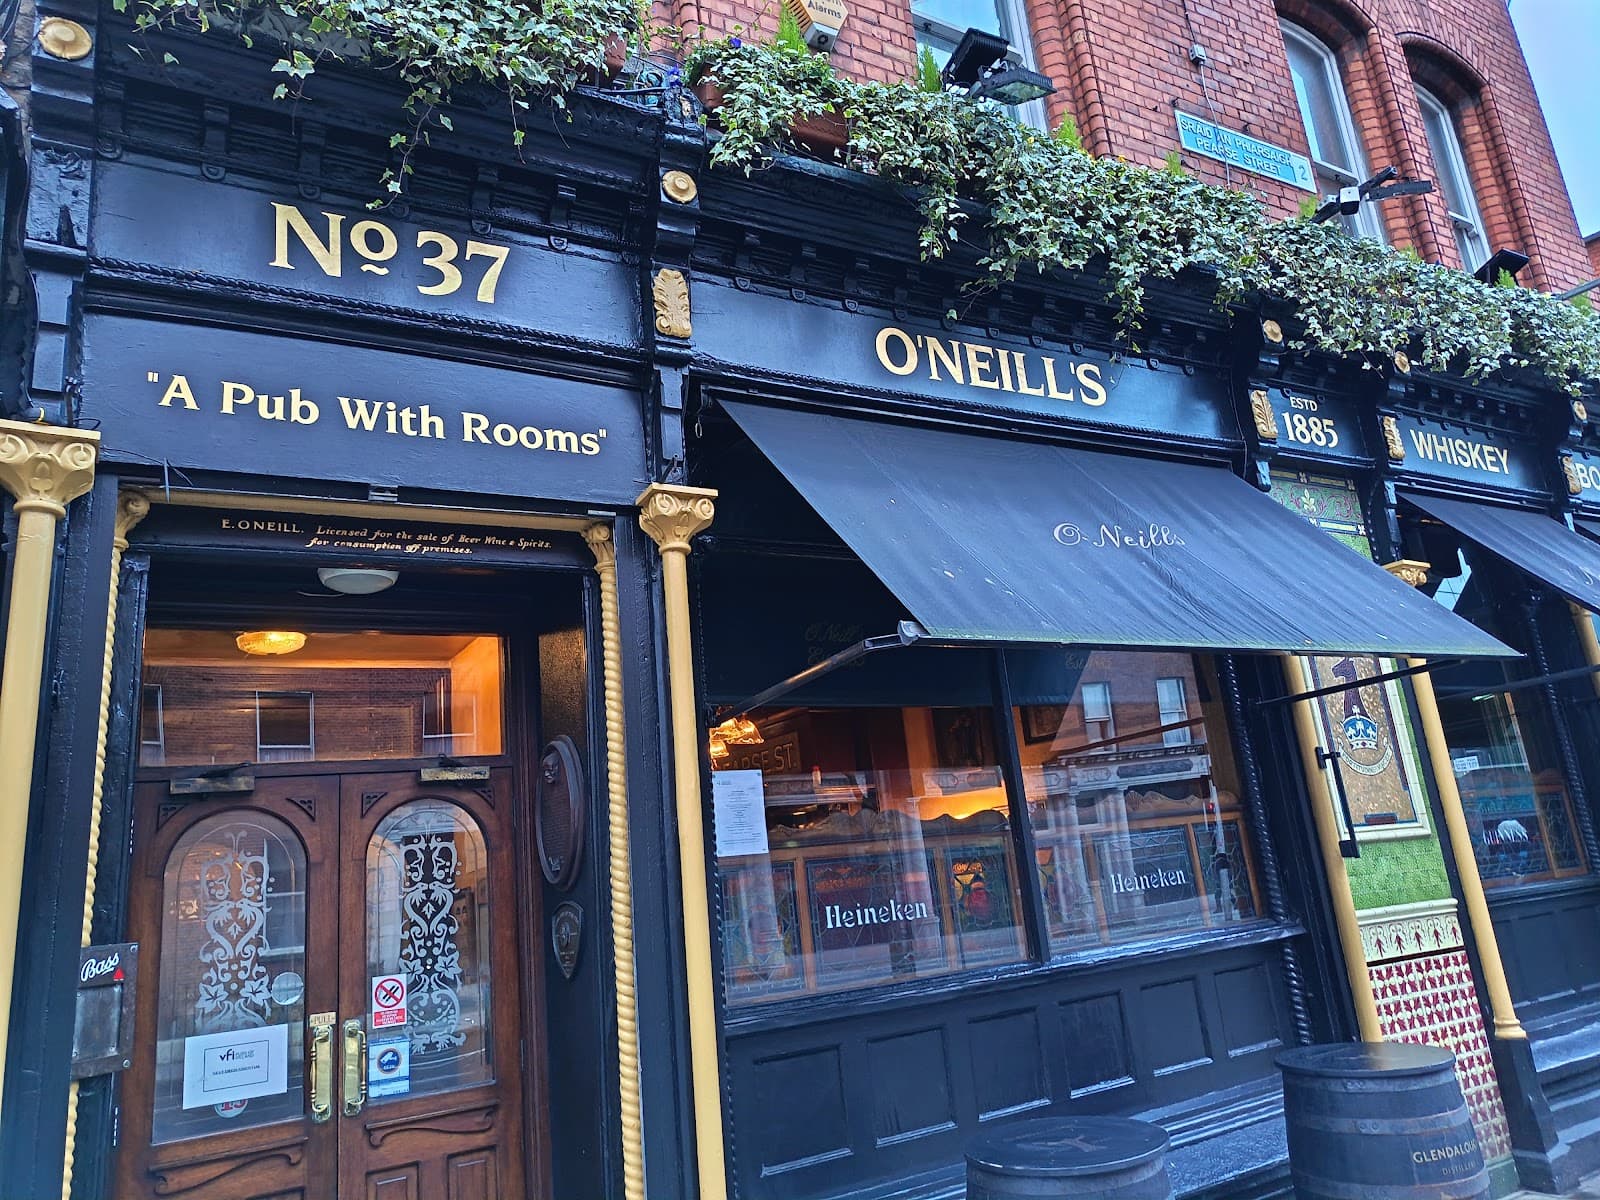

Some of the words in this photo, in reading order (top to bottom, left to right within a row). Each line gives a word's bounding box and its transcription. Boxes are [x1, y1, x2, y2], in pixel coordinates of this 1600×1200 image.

[807, 0, 841, 19] Alarms
[1196, 138, 1239, 161] PEARSE
[1243, 154, 1281, 175] STREET
[1298, 164, 1308, 181] 2
[416, 230, 510, 304] 37
[875, 327, 1107, 406] O'NEILL'S
[147, 371, 200, 411] "A
[220, 380, 320, 425] Pub
[336, 396, 446, 440] With
[461, 411, 607, 456] Rooms"
[1290, 397, 1318, 411] ESTD
[1282, 412, 1338, 448] 1885
[1410, 429, 1509, 475] WHISKEY
[305, 537, 329, 548] for
[334, 540, 402, 551] consumption
[421, 544, 473, 554] premises.
[316, 525, 368, 537] Licensed
[368, 529, 393, 541] for
[396, 531, 413, 540] the
[416, 532, 438, 542] sale
[441, 533, 455, 545] of
[458, 534, 481, 544] Beer
[484, 535, 506, 546] Wine
[1110, 868, 1186, 894] Heineken
[825, 899, 928, 929] Heineken
[81, 952, 120, 981] Bass
